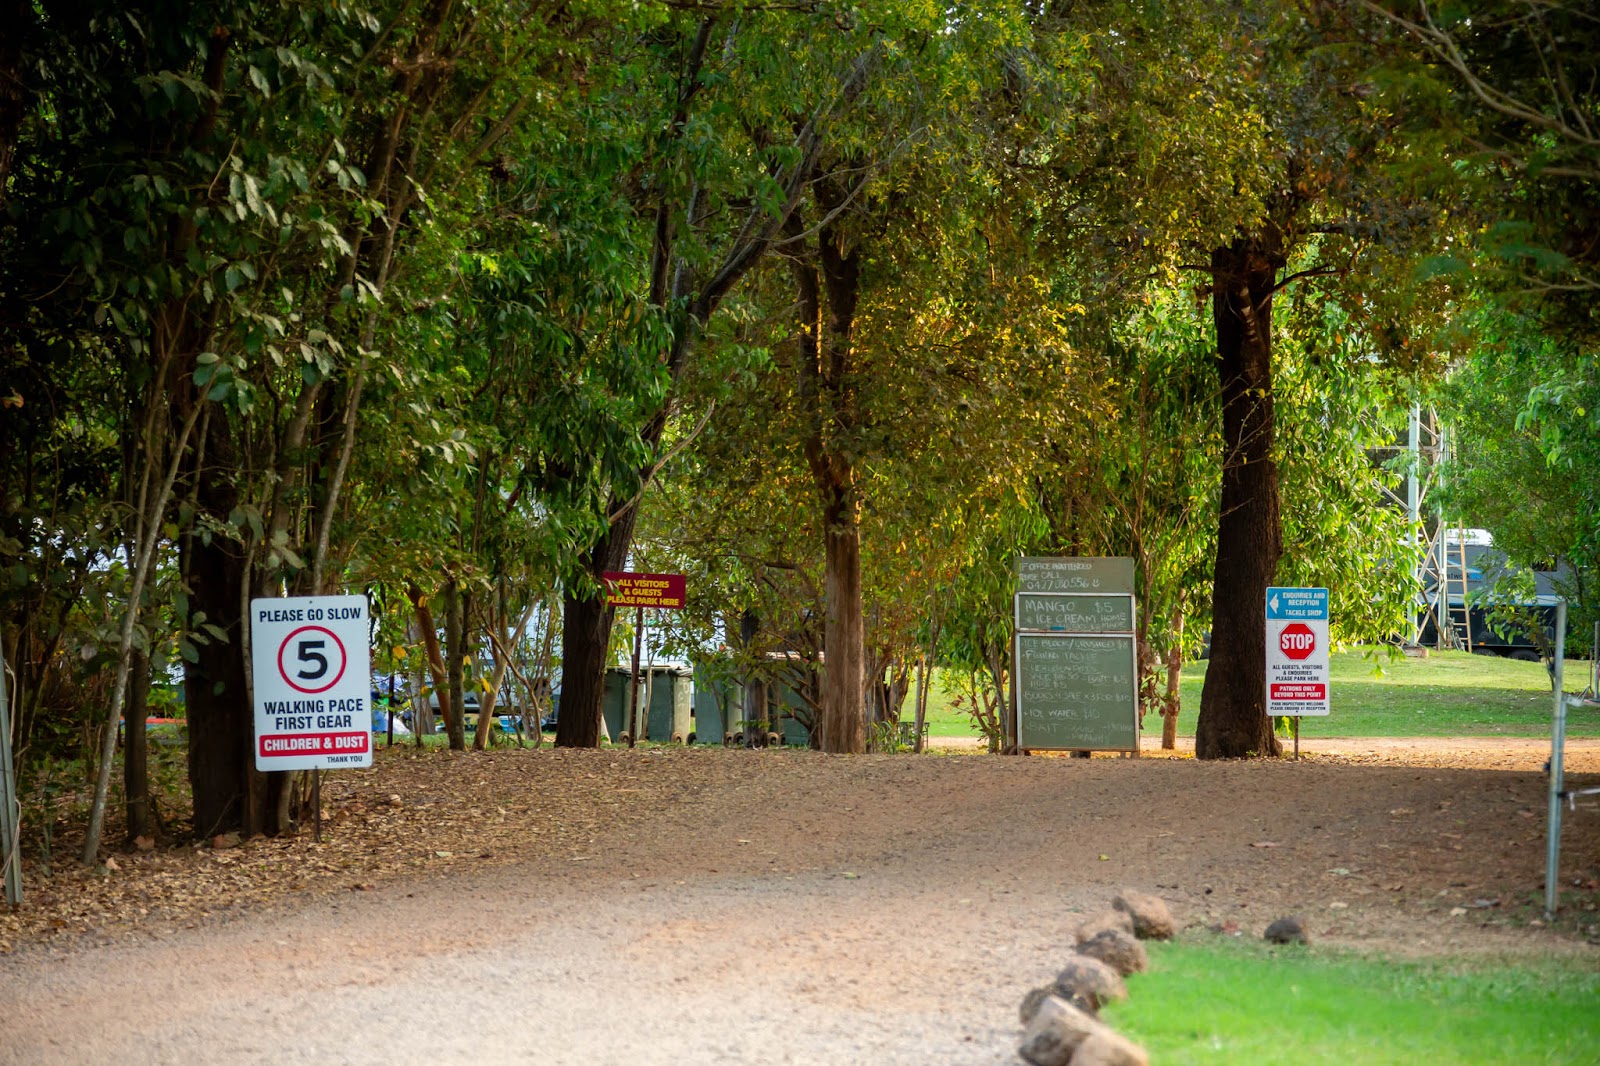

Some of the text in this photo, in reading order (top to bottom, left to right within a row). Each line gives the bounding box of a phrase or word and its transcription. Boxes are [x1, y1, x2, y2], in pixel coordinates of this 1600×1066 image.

[1040, 571, 1062, 579] CALL
[618, 579, 670, 588] ALL VISITORS
[632, 588, 662, 596] GUESTS
[607, 596, 679, 606] PLEASE PARK HERE
[1025, 599, 1113, 613] MANGO $5
[259, 607, 361, 622] PLEASE GO SLOW
[1036, 613, 1052, 624] ICE
[1056, 613, 1096, 623] CREAM
[1281, 633, 1314, 650] STOP
[297, 640, 328, 680] 5
[264, 698, 363, 715] WALKING PACE
[1048, 709, 1079, 718] WATER
[275, 715, 352, 730] FIRST GEAR
[264, 735, 364, 752] CHILDREN & DUST
[327, 756, 349, 764] THANK
